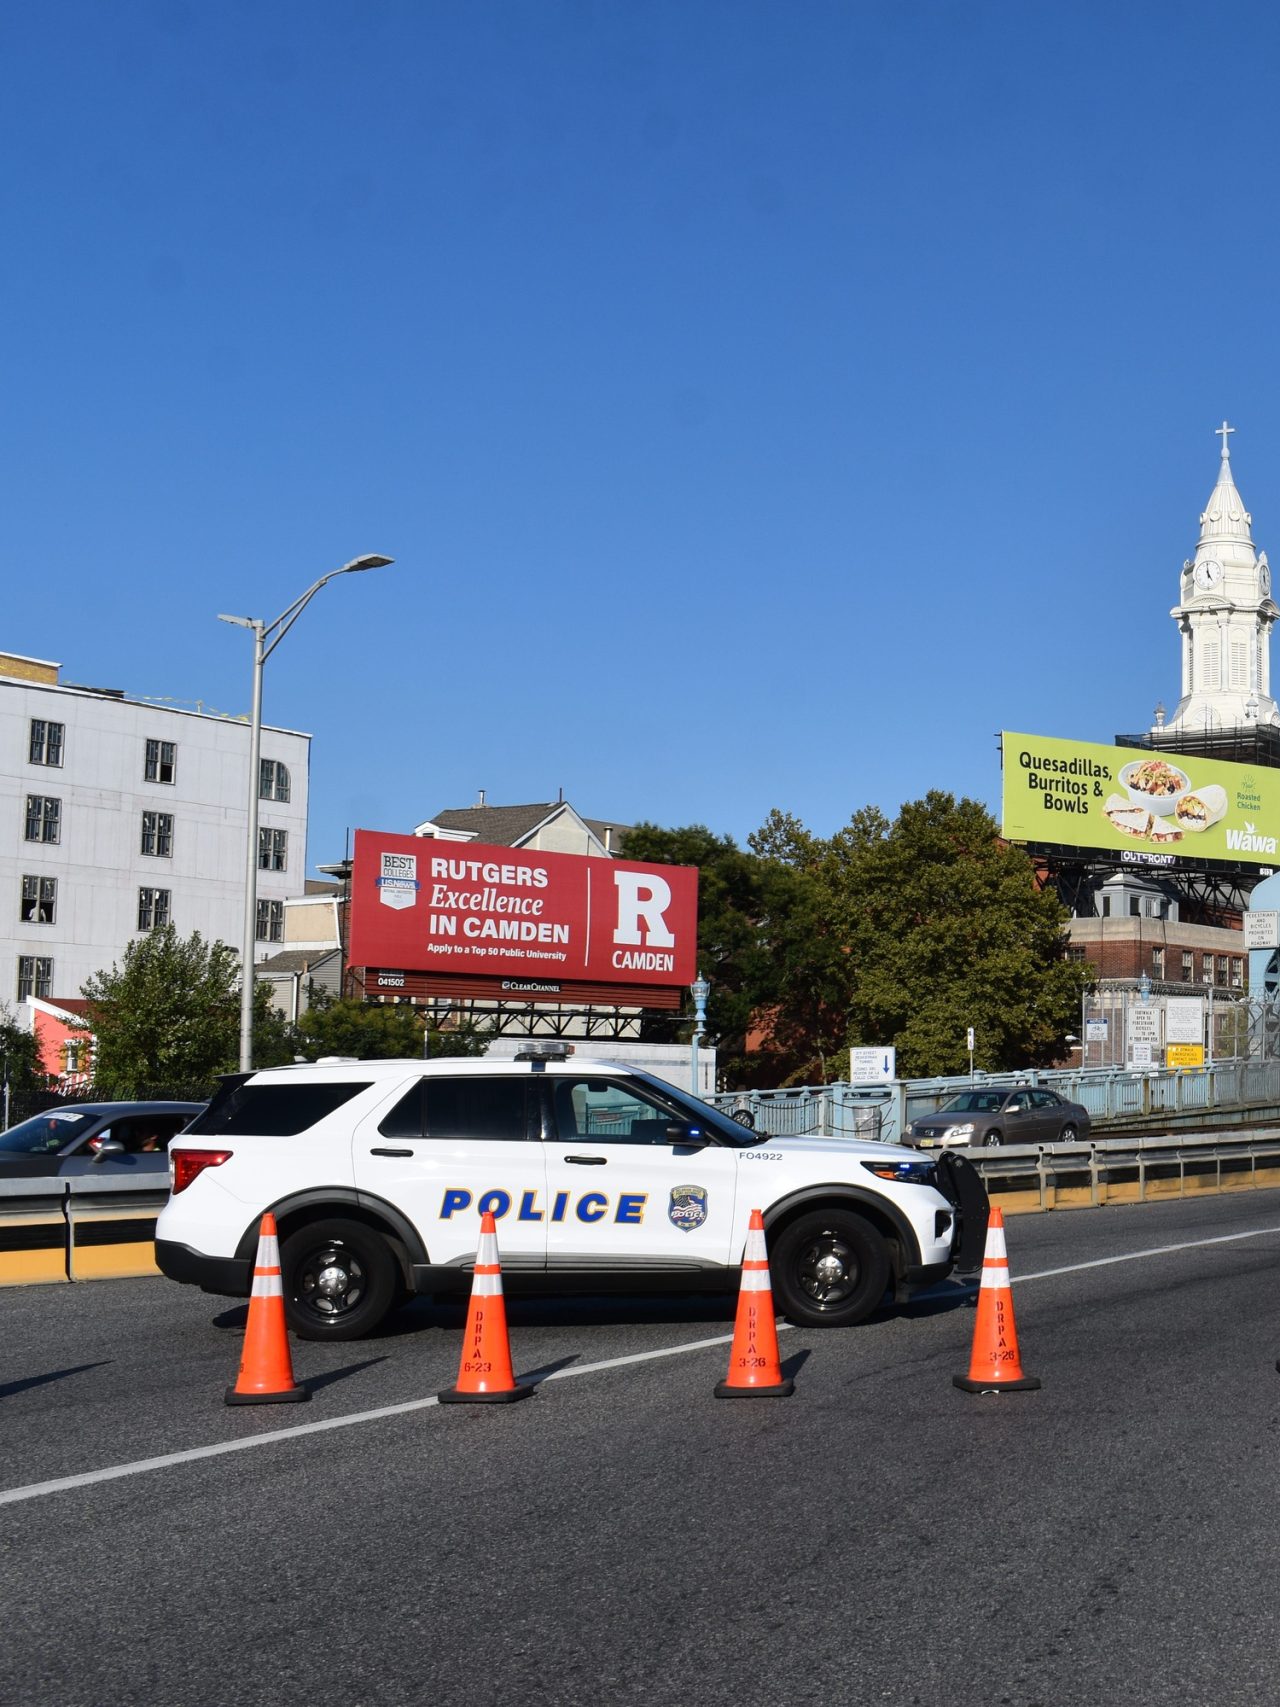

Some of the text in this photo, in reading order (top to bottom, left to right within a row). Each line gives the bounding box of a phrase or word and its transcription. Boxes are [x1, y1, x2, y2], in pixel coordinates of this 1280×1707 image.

[1019, 752, 1112, 781] Quesadillas,
[1028, 772, 1104, 797] Burritos &
[1237, 792, 1260, 801] Roasted
[1044, 792, 1088, 815] Bowls
[1237, 802, 1260, 811] Chicken
[1226, 829, 1276, 854] Wawa
[384, 856, 414, 869] BEST
[384, 868, 414, 878] COLLEGES
[431, 858, 547, 888] RUTGERS
[429, 884, 543, 916] Excellence
[613, 870, 674, 948] R
[430, 914, 569, 944] IN CAMDEN
[427, 943, 452, 955] Apply
[454, 945, 462, 954] to
[471, 946, 486, 957] Top
[488, 947, 498, 956] 50
[500, 948, 525, 958] Public
[526, 949, 566, 961] University
[612, 950, 674, 972] CAMDEN
[378, 977, 404, 987] 041502
[438, 1187, 650, 1225] POLICE
[473, 1311, 483, 1358] DRPA
[748, 1307, 756, 1354] DRPA
[996, 1301, 1006, 1347] DRPA
[464, 1362, 491, 1372] 6-23
